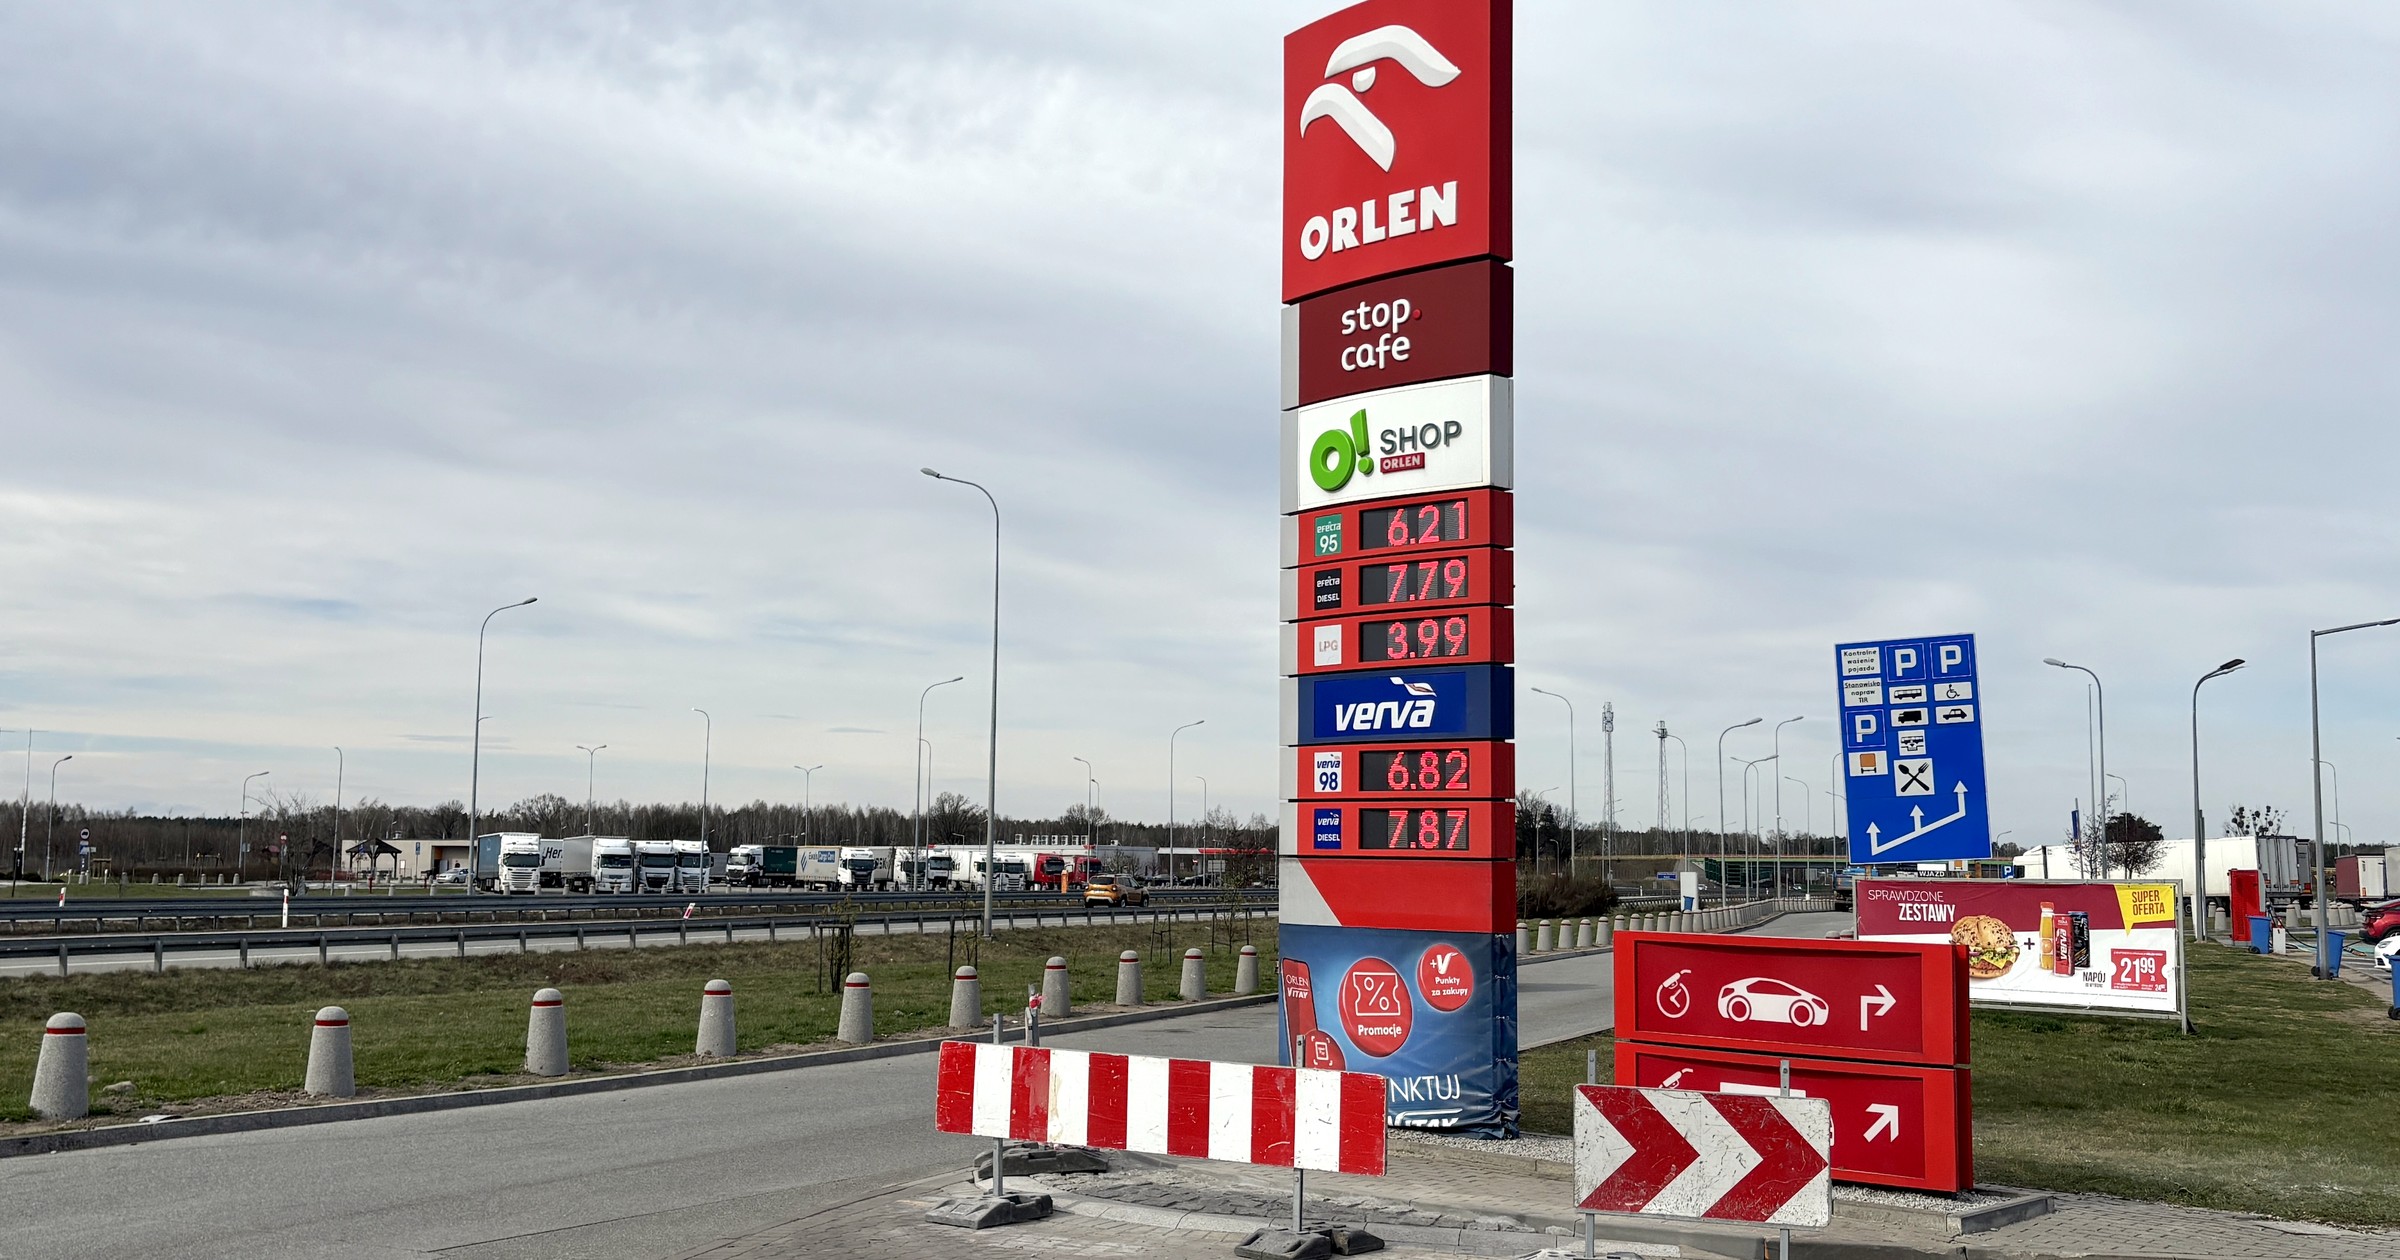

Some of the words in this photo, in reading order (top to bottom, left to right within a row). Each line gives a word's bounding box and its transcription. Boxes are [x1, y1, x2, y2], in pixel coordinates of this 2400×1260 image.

[1299, 180, 1458, 262] ORLEN
[1341, 333, 1411, 373] cafe
[1380, 420, 1462, 455] SHOP
[1382, 455, 1421, 470] ORLEN
[1388, 501, 1466, 547] 6.21
[1319, 534, 1338, 554] 95
[1388, 559, 1466, 603] 7.79
[1316, 593, 1340, 603] DIESEL
[1318, 639, 1338, 653] LPG
[1387, 617, 1466, 660] 3.99
[1895, 648, 1917, 676] P
[1940, 645, 1962, 673] P
[1847, 665, 1876, 673] pojazdu
[1844, 681, 1881, 689] Stanowisko
[1335, 700, 1436, 731] verva
[1855, 715, 1877, 743] P
[1316, 759, 1341, 769] verva
[1388, 751, 1468, 790] 6.82
[1319, 772, 1338, 791] 98
[1317, 817, 1340, 826] verva
[1388, 810, 1468, 849] 7.87
[1317, 833, 1341, 842] DIESEL
[2004, 865, 2012, 876] P
[1867, 889, 1945, 902] SPRAWDZONE
[2131, 890, 2160, 903] SUPER
[1898, 903, 1956, 922] ZESTAWY
[2132, 904, 2165, 916] OFERTA
[1285, 974, 1309, 987] ORLEN
[1434, 976, 1460, 986] Punkty
[2082, 970, 2106, 983] NAPÓJ
[1287, 987, 1308, 999] VITAY
[1431, 989, 1441, 997] za
[1442, 987, 1468, 997] zakupy
[1357, 1023, 1402, 1038] Promocje
[1389, 1074, 1461, 1102] NKTUJ
